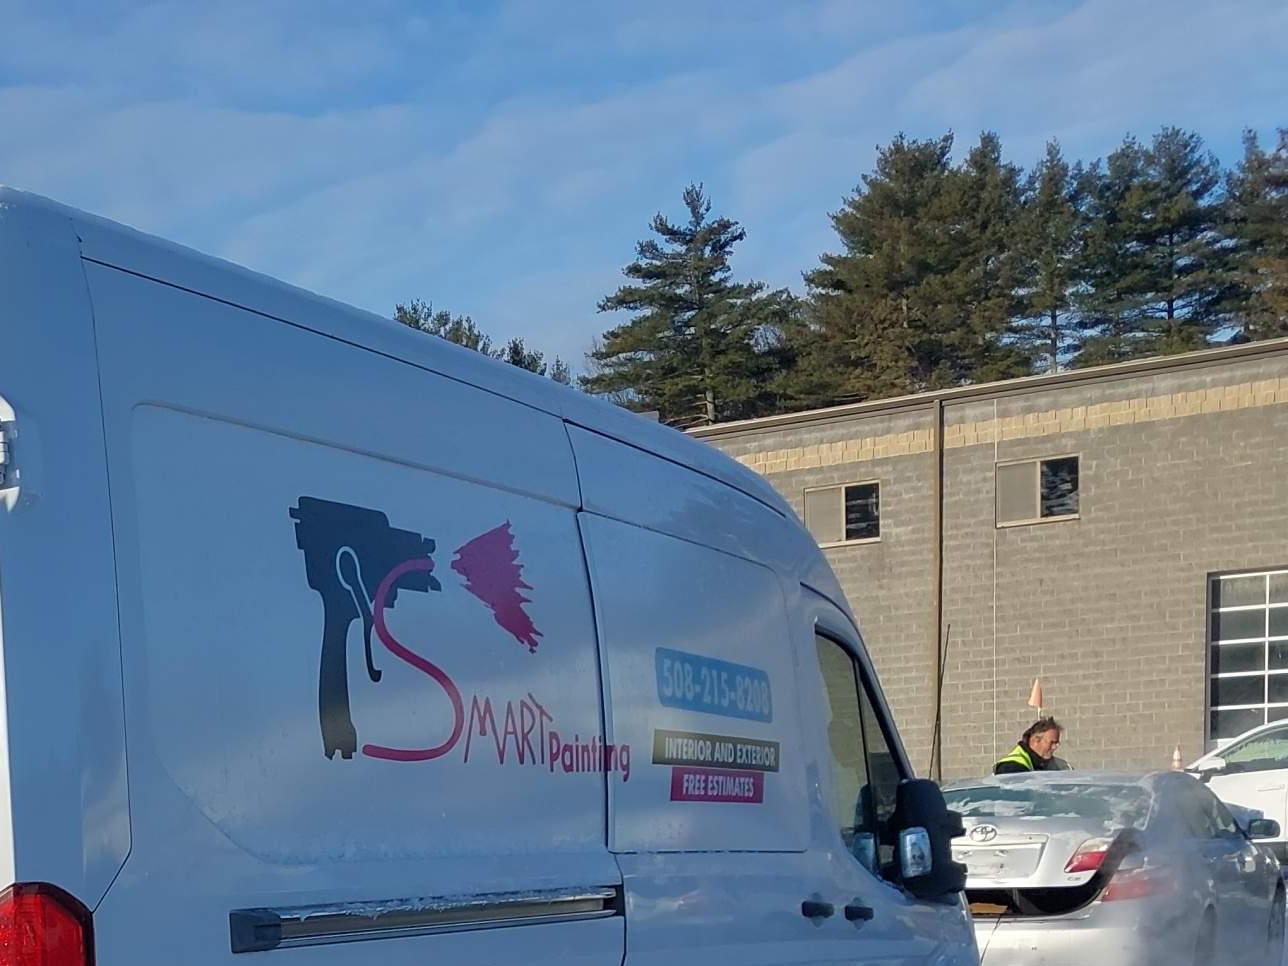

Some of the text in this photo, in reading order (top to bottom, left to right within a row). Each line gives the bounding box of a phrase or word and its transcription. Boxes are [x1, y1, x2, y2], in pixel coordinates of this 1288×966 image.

[663, 658, 770, 715] 508-215-8208
[665, 736, 775, 767] INTERIOR AND EXTERIOR
[682, 774, 754, 797] FREE ESTIMATES
